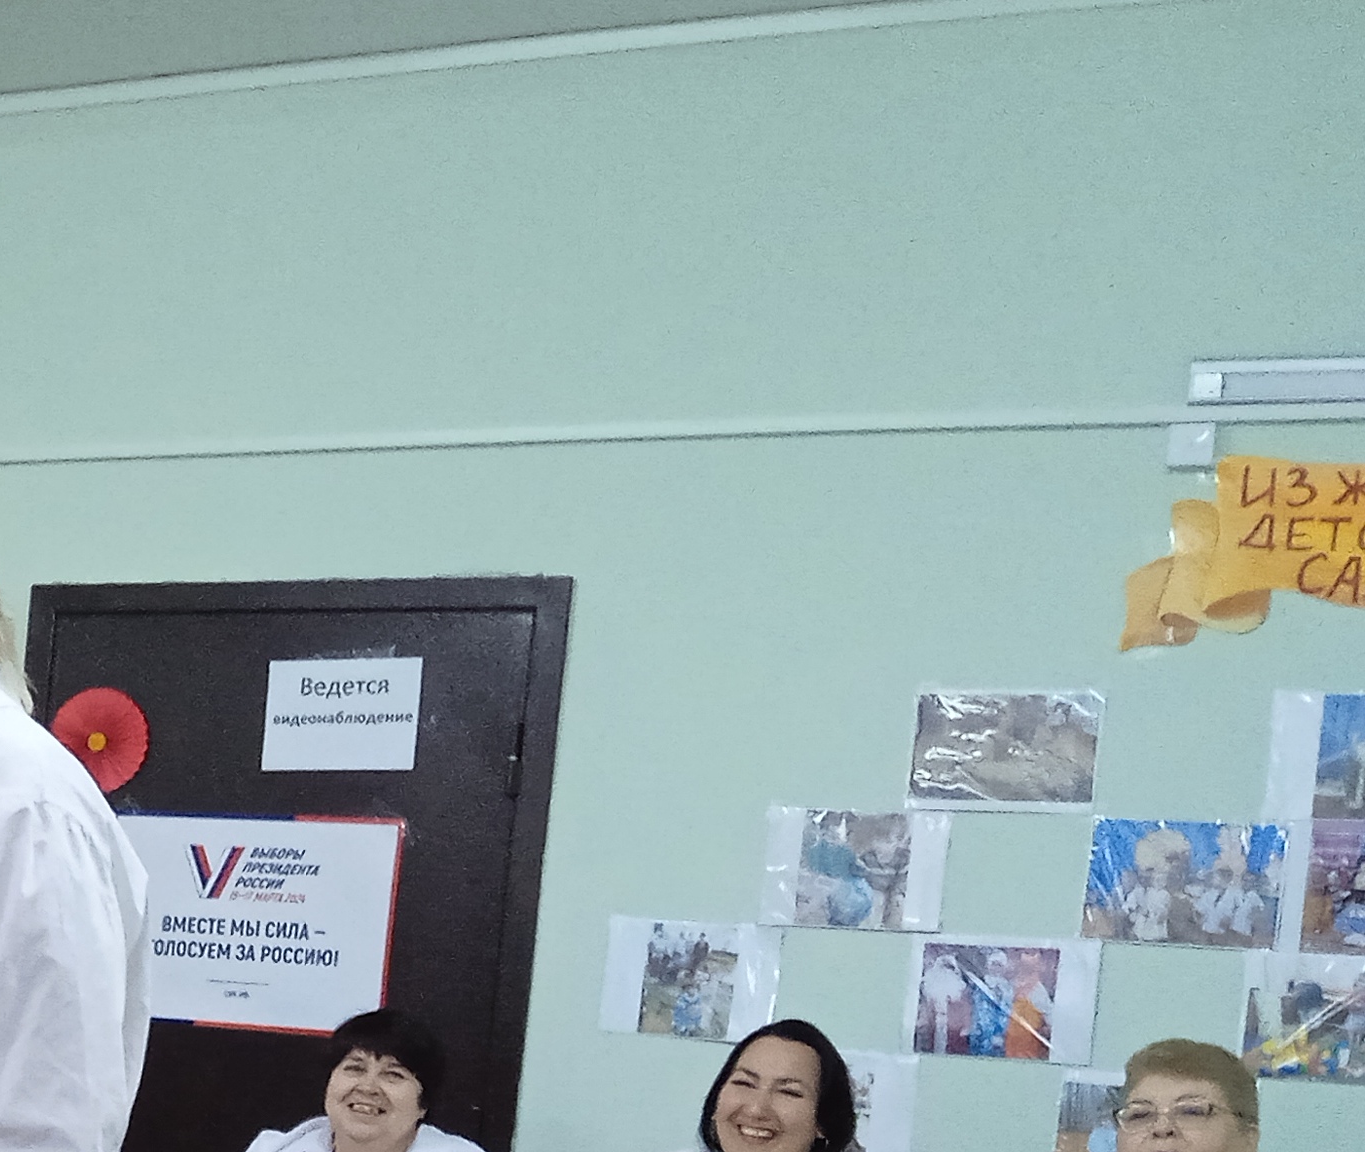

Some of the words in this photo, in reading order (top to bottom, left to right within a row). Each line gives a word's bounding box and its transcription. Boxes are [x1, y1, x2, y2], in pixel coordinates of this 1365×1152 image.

[1241, 464, 1318, 508] ИЗ
[1297, 552, 1365, 604] СА
[300, 677, 390, 699] Ведется
[273, 710, 414, 727] видеонаблюдение
[250, 847, 306, 861] ВЫБОРЫ
[242, 861, 320, 877] ПРЕЗИДЕНТА
[235, 876, 286, 890] РОССИИ
[162, 915, 226, 936] ВМЕСТЕ
[230, 919, 260, 938] МЫ
[265, 921, 309, 940] СИЛА
[151, 938, 231, 960] ОЛОСУЕМ
[235, 943, 255, 962] ЗА
[260, 945, 339, 967] РОССИЮ!
